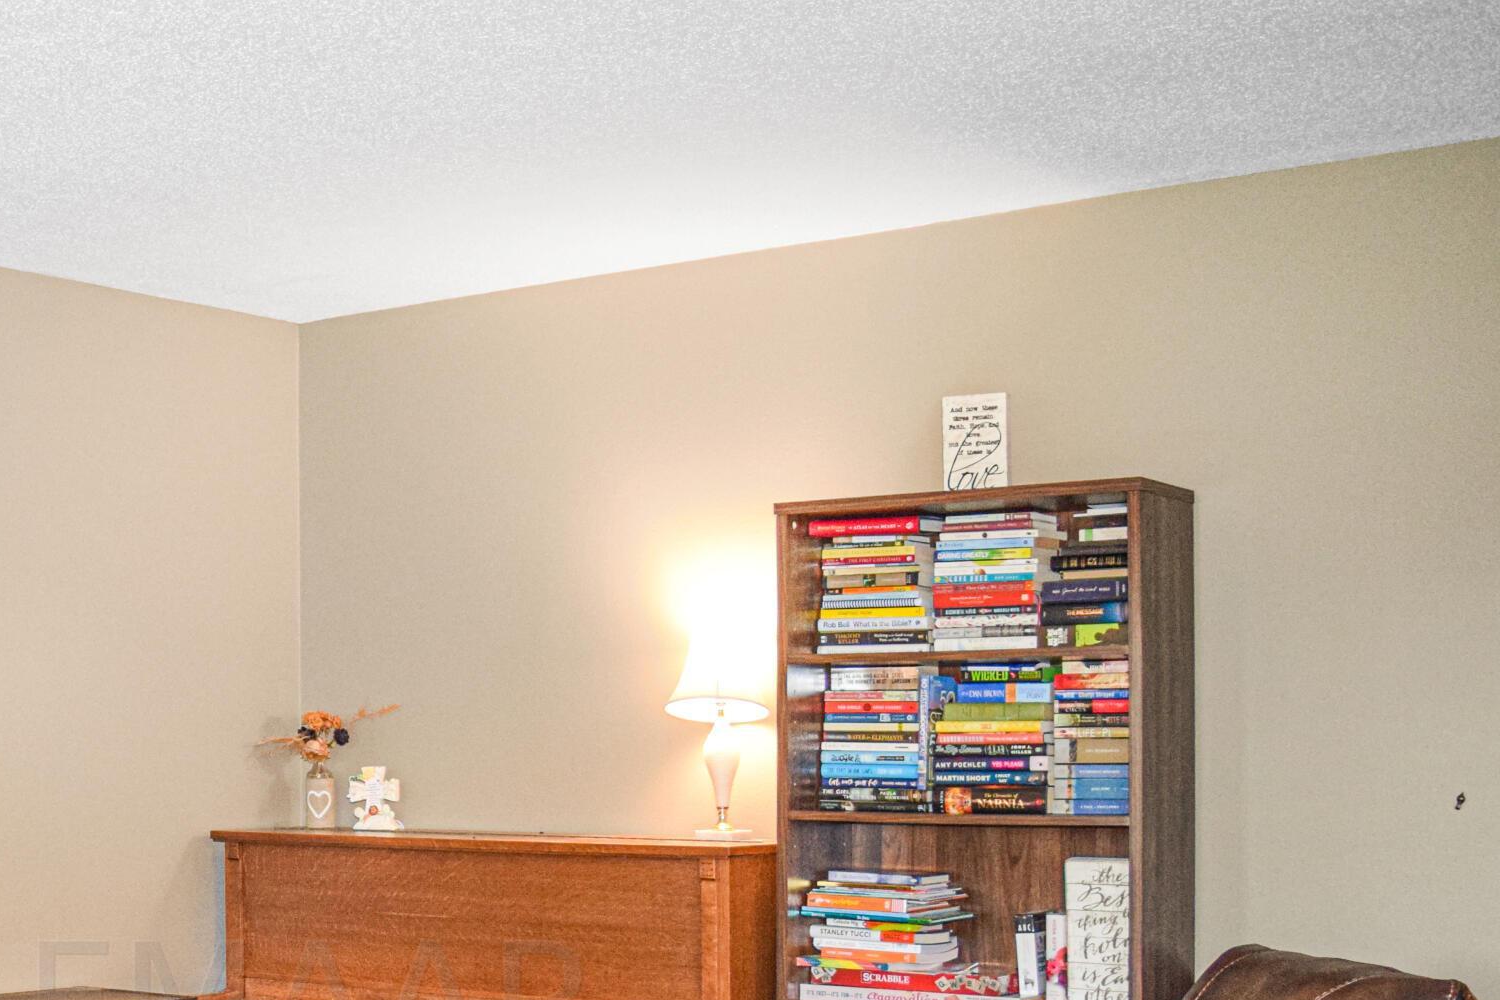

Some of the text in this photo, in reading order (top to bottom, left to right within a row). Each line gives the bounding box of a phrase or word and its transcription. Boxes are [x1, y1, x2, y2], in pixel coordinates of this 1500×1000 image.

[853, 620, 870, 628] What
[971, 670, 1009, 681] WICKED
[1078, 728, 1095, 737] LIFE
[977, 798, 1025, 808] NARNIA
[1092, 866, 1126, 884] the
[1077, 880, 1129, 911] Bes
[820, 928, 871, 938] STANLEY TUCCI
[862, 972, 910, 984] SCRABBLE
[1082, 967, 1102, 984] is
[1101, 965, 1129, 987] Ea
